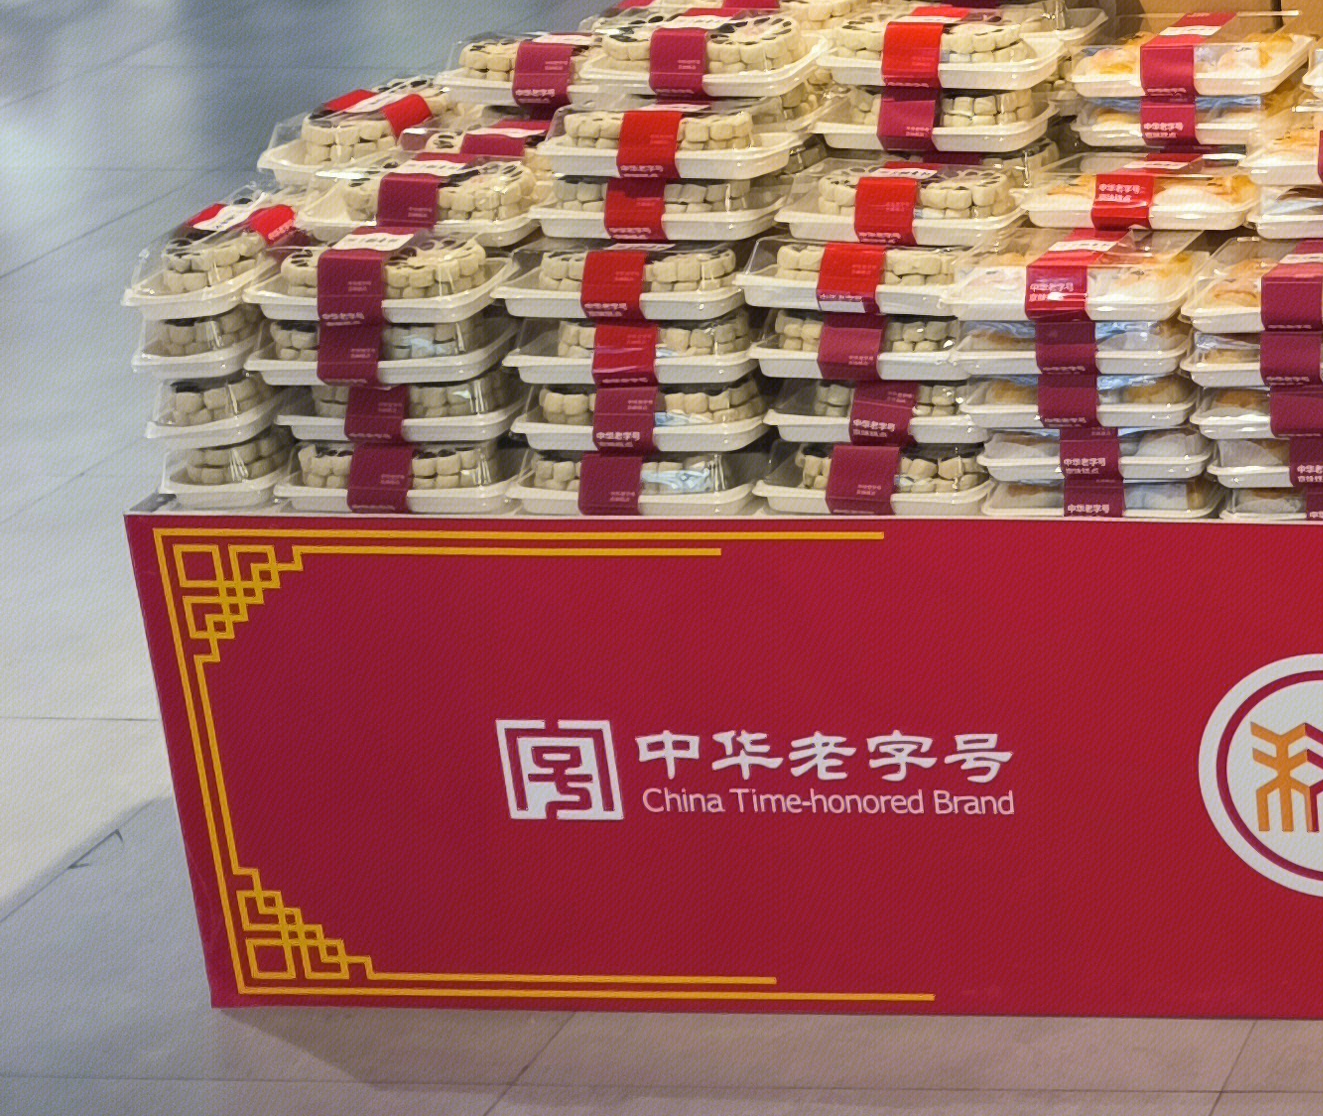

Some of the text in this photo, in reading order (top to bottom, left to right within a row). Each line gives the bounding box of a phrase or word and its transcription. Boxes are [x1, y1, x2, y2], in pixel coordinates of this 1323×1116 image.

[637, 729, 1014, 783] 中华老字号
[641, 788, 1015, 816] China Time-honored Brand
